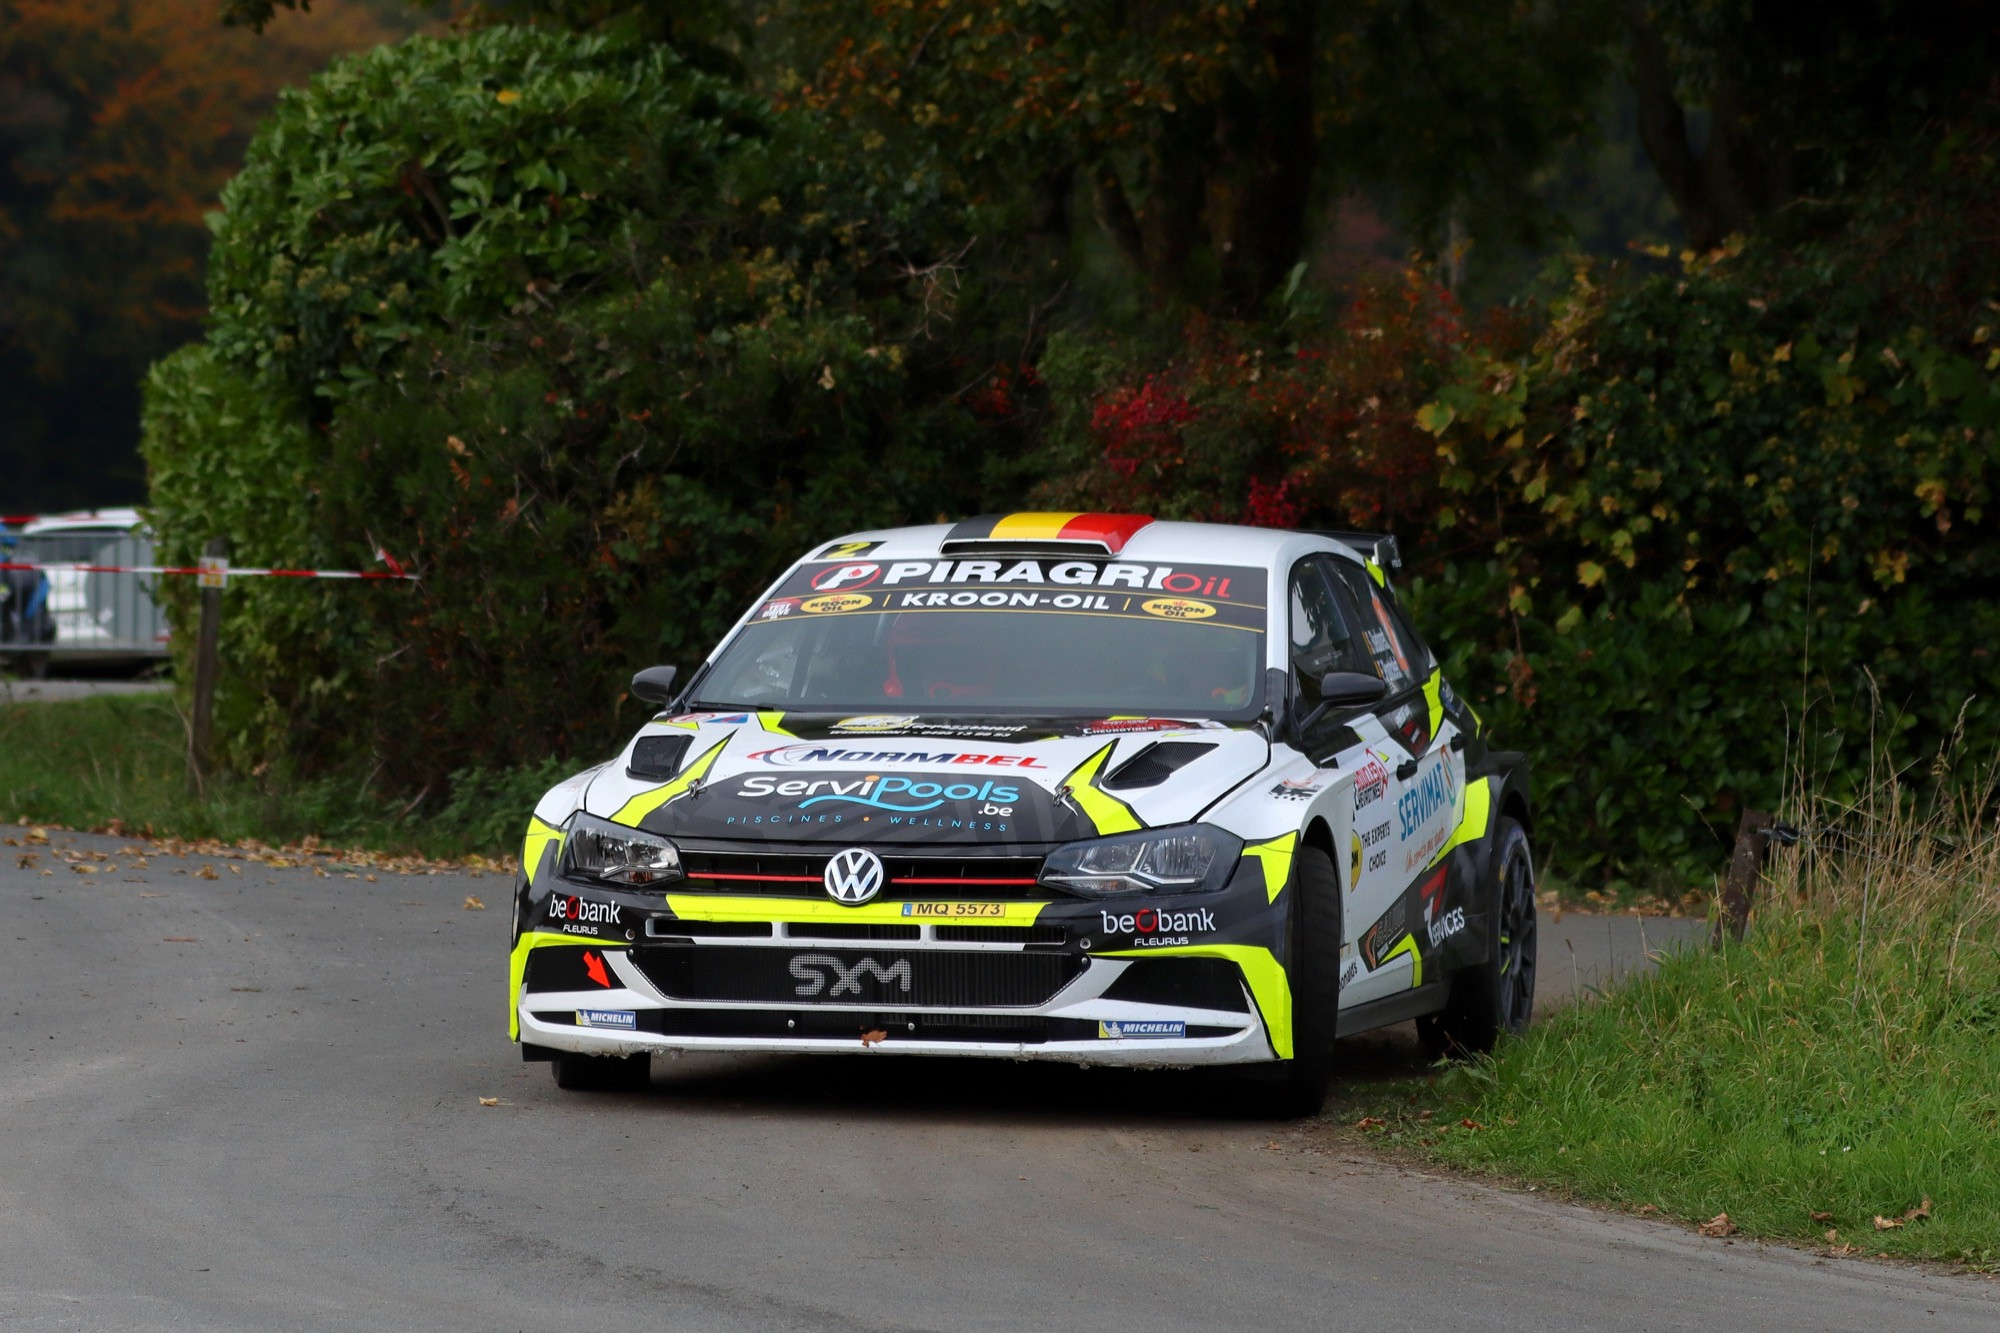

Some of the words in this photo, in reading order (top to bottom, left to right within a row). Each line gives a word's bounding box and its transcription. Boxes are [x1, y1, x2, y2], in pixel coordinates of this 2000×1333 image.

[826, 541, 871, 559] 2
[810, 599, 862, 609] KROON
[900, 592, 1110, 610] KROON-OIL
[1152, 603, 1206, 614] KROON
[1163, 610, 1187, 618] OIL
[801, 749, 1048, 769] NORMBEL
[737, 775, 1020, 804] ServiPools
[1398, 762, 1446, 842] SERVIMAT
[977, 803, 1013, 818] .be
[727, 815, 843, 825] PISCINES
[889, 816, 1007, 832] WELLNESS
[1361, 832, 1371, 850] THE
[1368, 849, 1387, 873] CHOICE
[916, 903, 949, 915] MQ
[955, 903, 1001, 915] 5573
[562, 924, 598, 935] FLEURUS
[1134, 936, 1189, 946] FLEURUS
[789, 954, 911, 996] SXM
[590, 1013, 634, 1024] MICHELIN
[1122, 1023, 1183, 1033] MICHELIN
